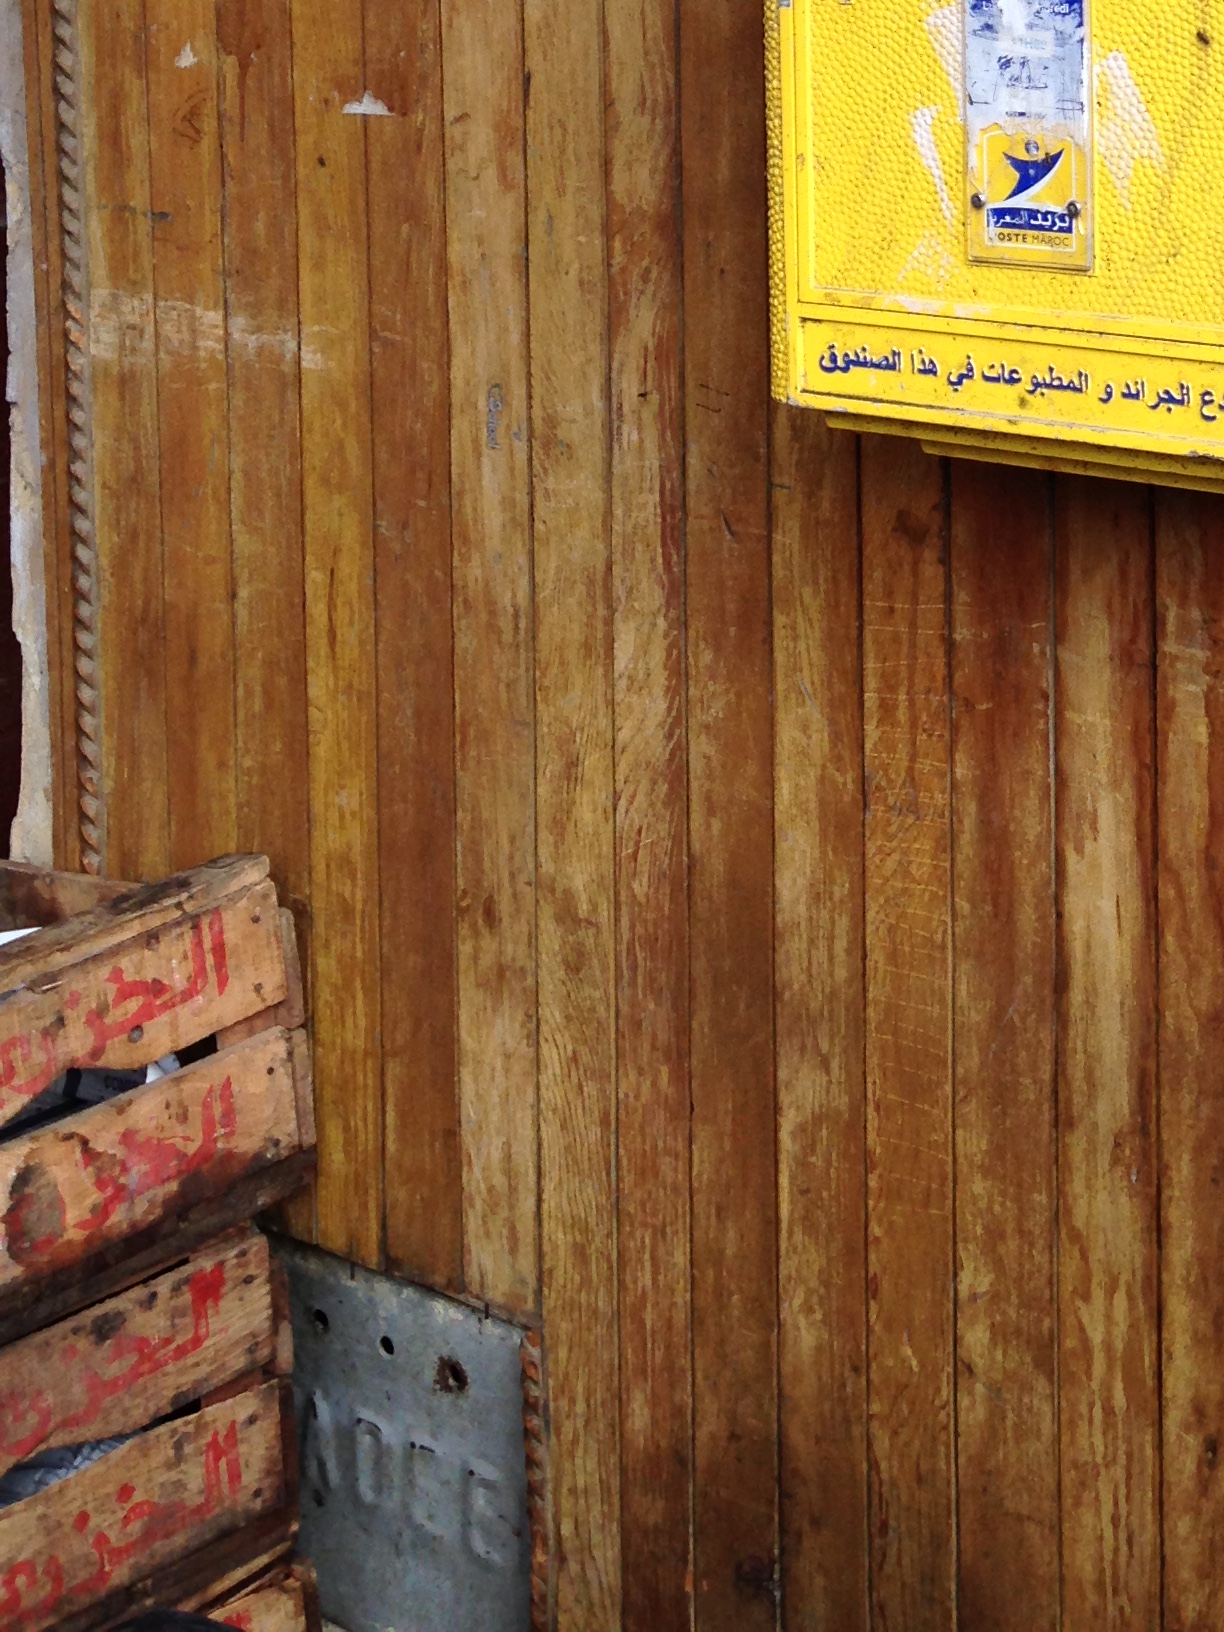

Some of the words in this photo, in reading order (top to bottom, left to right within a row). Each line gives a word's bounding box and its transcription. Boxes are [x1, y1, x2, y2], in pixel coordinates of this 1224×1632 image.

[1029, 212, 1070, 231] بريد
[996, 231, 1028, 244] OSTE
[1031, 234, 1070, 247] MAROC
[819, 343, 902, 374] الصندوق
[911, 347, 940, 377] هذا
[947, 354, 975, 392] في
[1099, 381, 1115, 404] و
